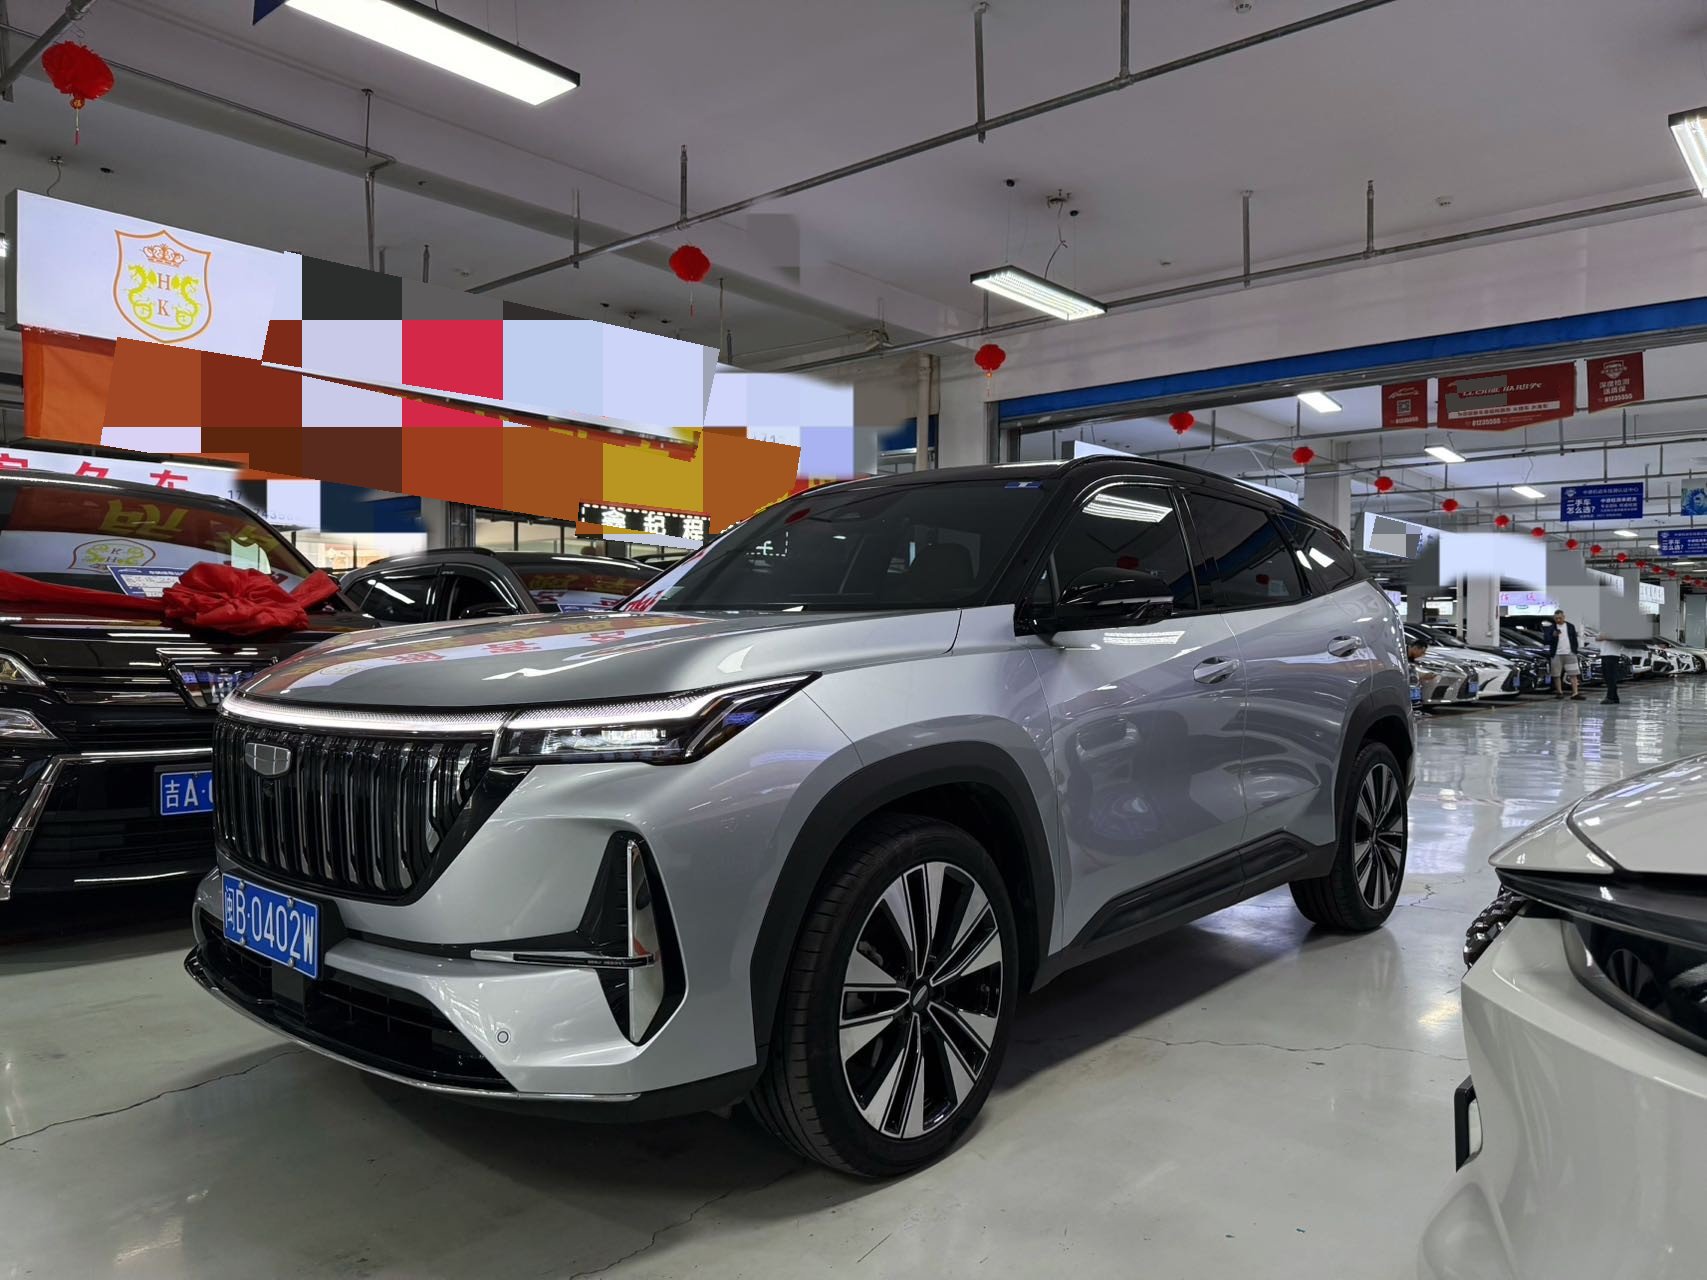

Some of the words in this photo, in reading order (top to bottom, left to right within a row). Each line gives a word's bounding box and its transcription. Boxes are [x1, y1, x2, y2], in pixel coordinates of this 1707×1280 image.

[157, 274, 171, 291] H
[157, 300, 170, 317] K
[165, 778, 213, 808] 吉A·
[224, 885, 315, 965] 闽B·0402W
